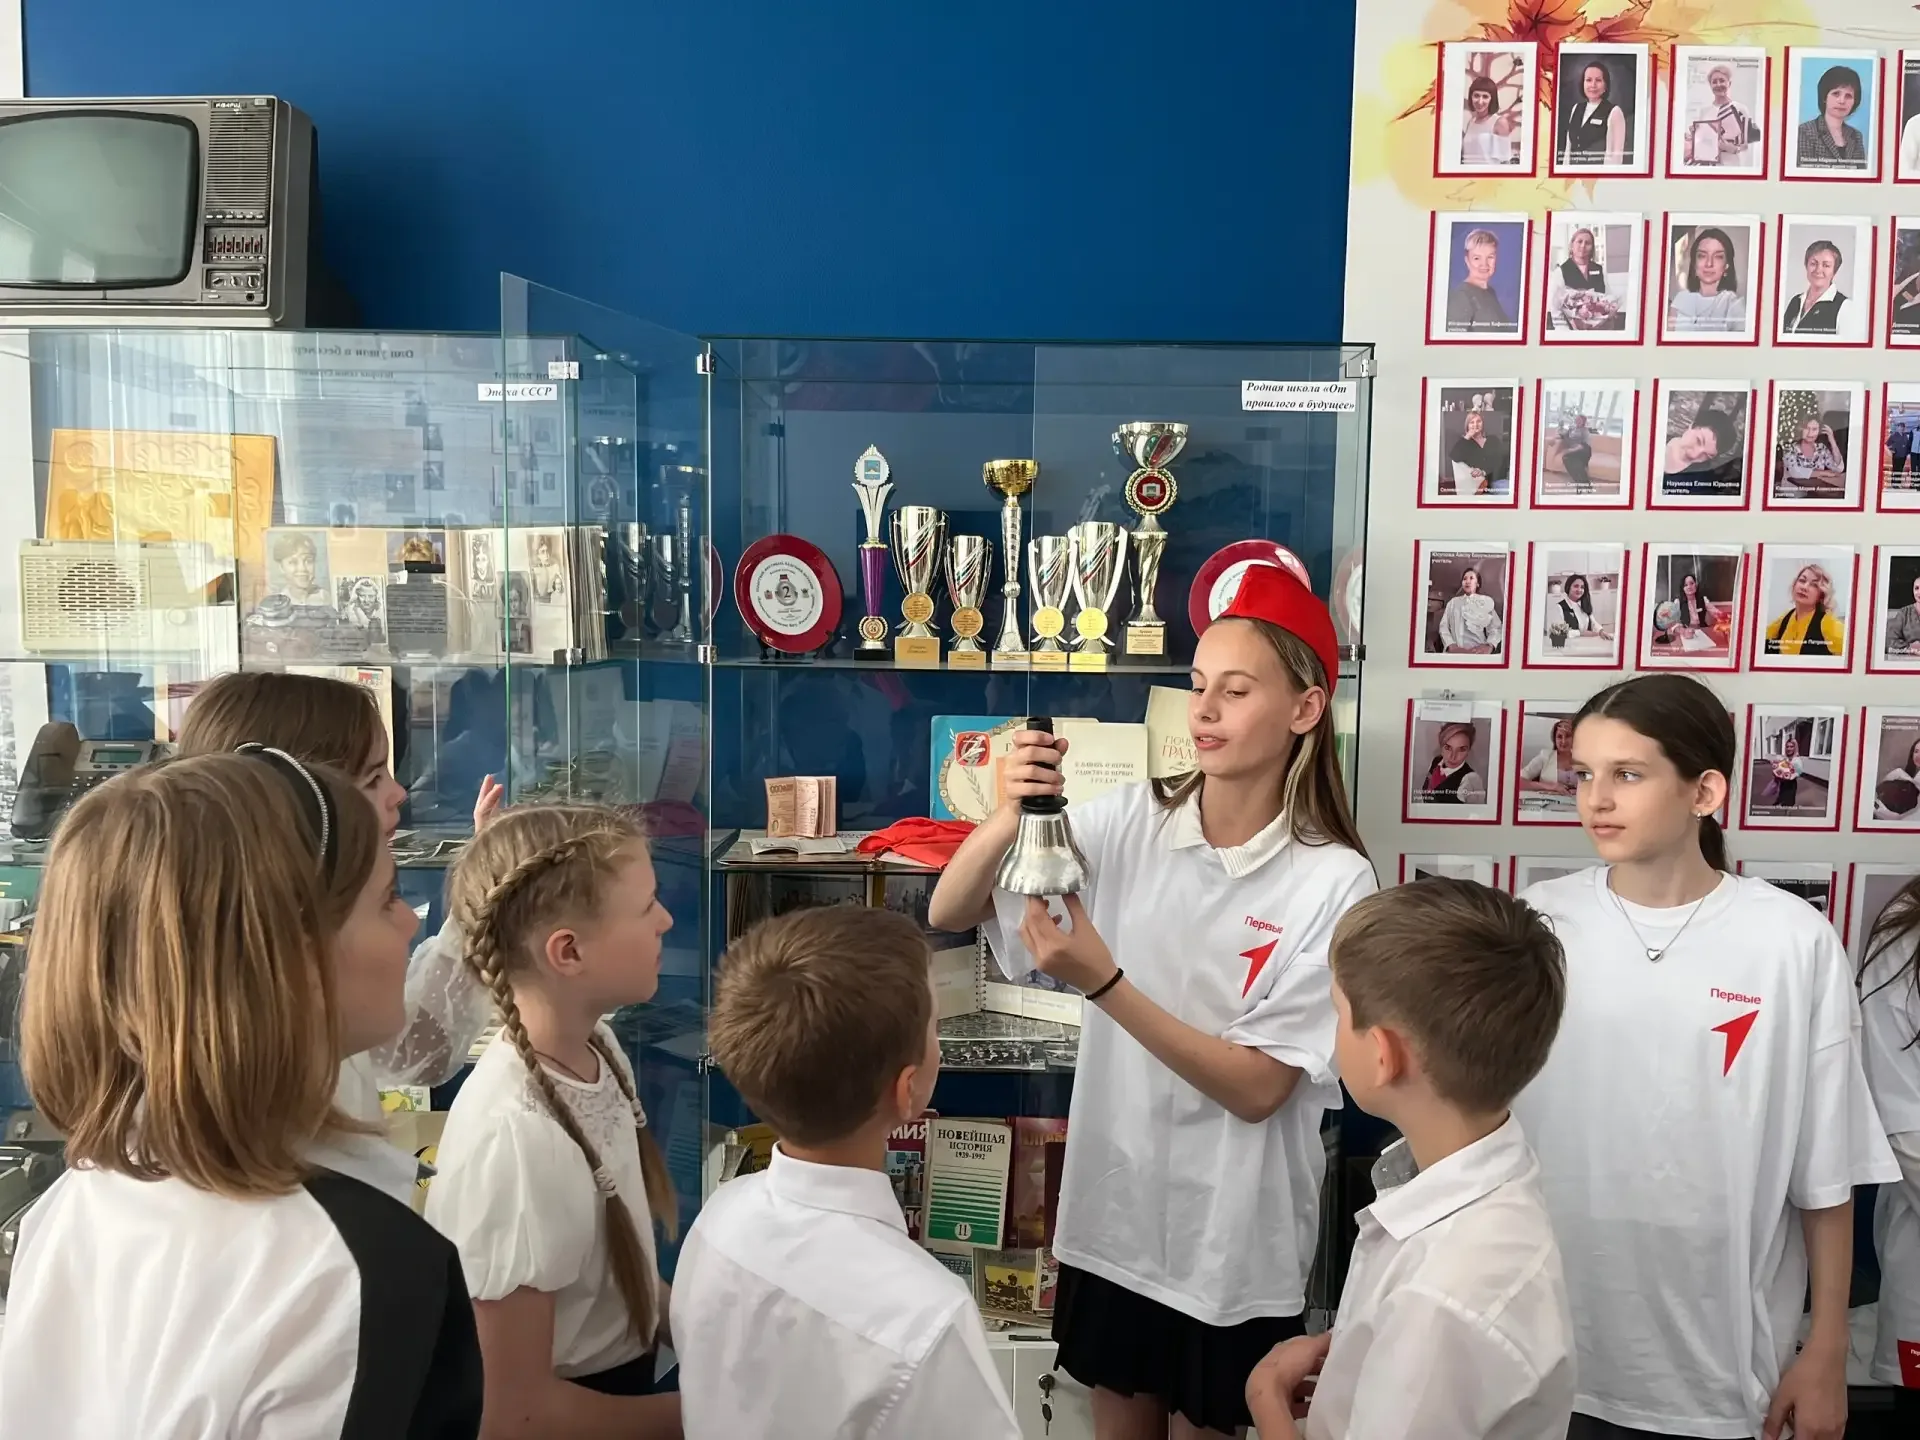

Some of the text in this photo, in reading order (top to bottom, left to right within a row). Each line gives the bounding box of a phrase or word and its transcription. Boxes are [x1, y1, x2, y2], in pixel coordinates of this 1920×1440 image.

[521, 386, 552, 397] СССР
[1246, 382, 1347, 394] Родная школа «От
[1245, 400, 1296, 410] прошлого
[1306, 400, 1355, 411] будущее»
[1666, 480, 1693, 488] Наумова
[782, 585, 792, 599] 2
[1165, 735, 1195, 747] ПОЧЕ
[1162, 744, 1199, 762] ГРАМ
[1710, 987, 1762, 1005] Первые
[887, 1123, 926, 1140] МИЯ
[937, 1128, 1006, 1145] НОВЕЙШАЯ
[949, 1142, 993, 1153] ИСТОРИЯ
[955, 1151, 986, 1161] 1939-1992
[957, 1224, 968, 1237] 11
